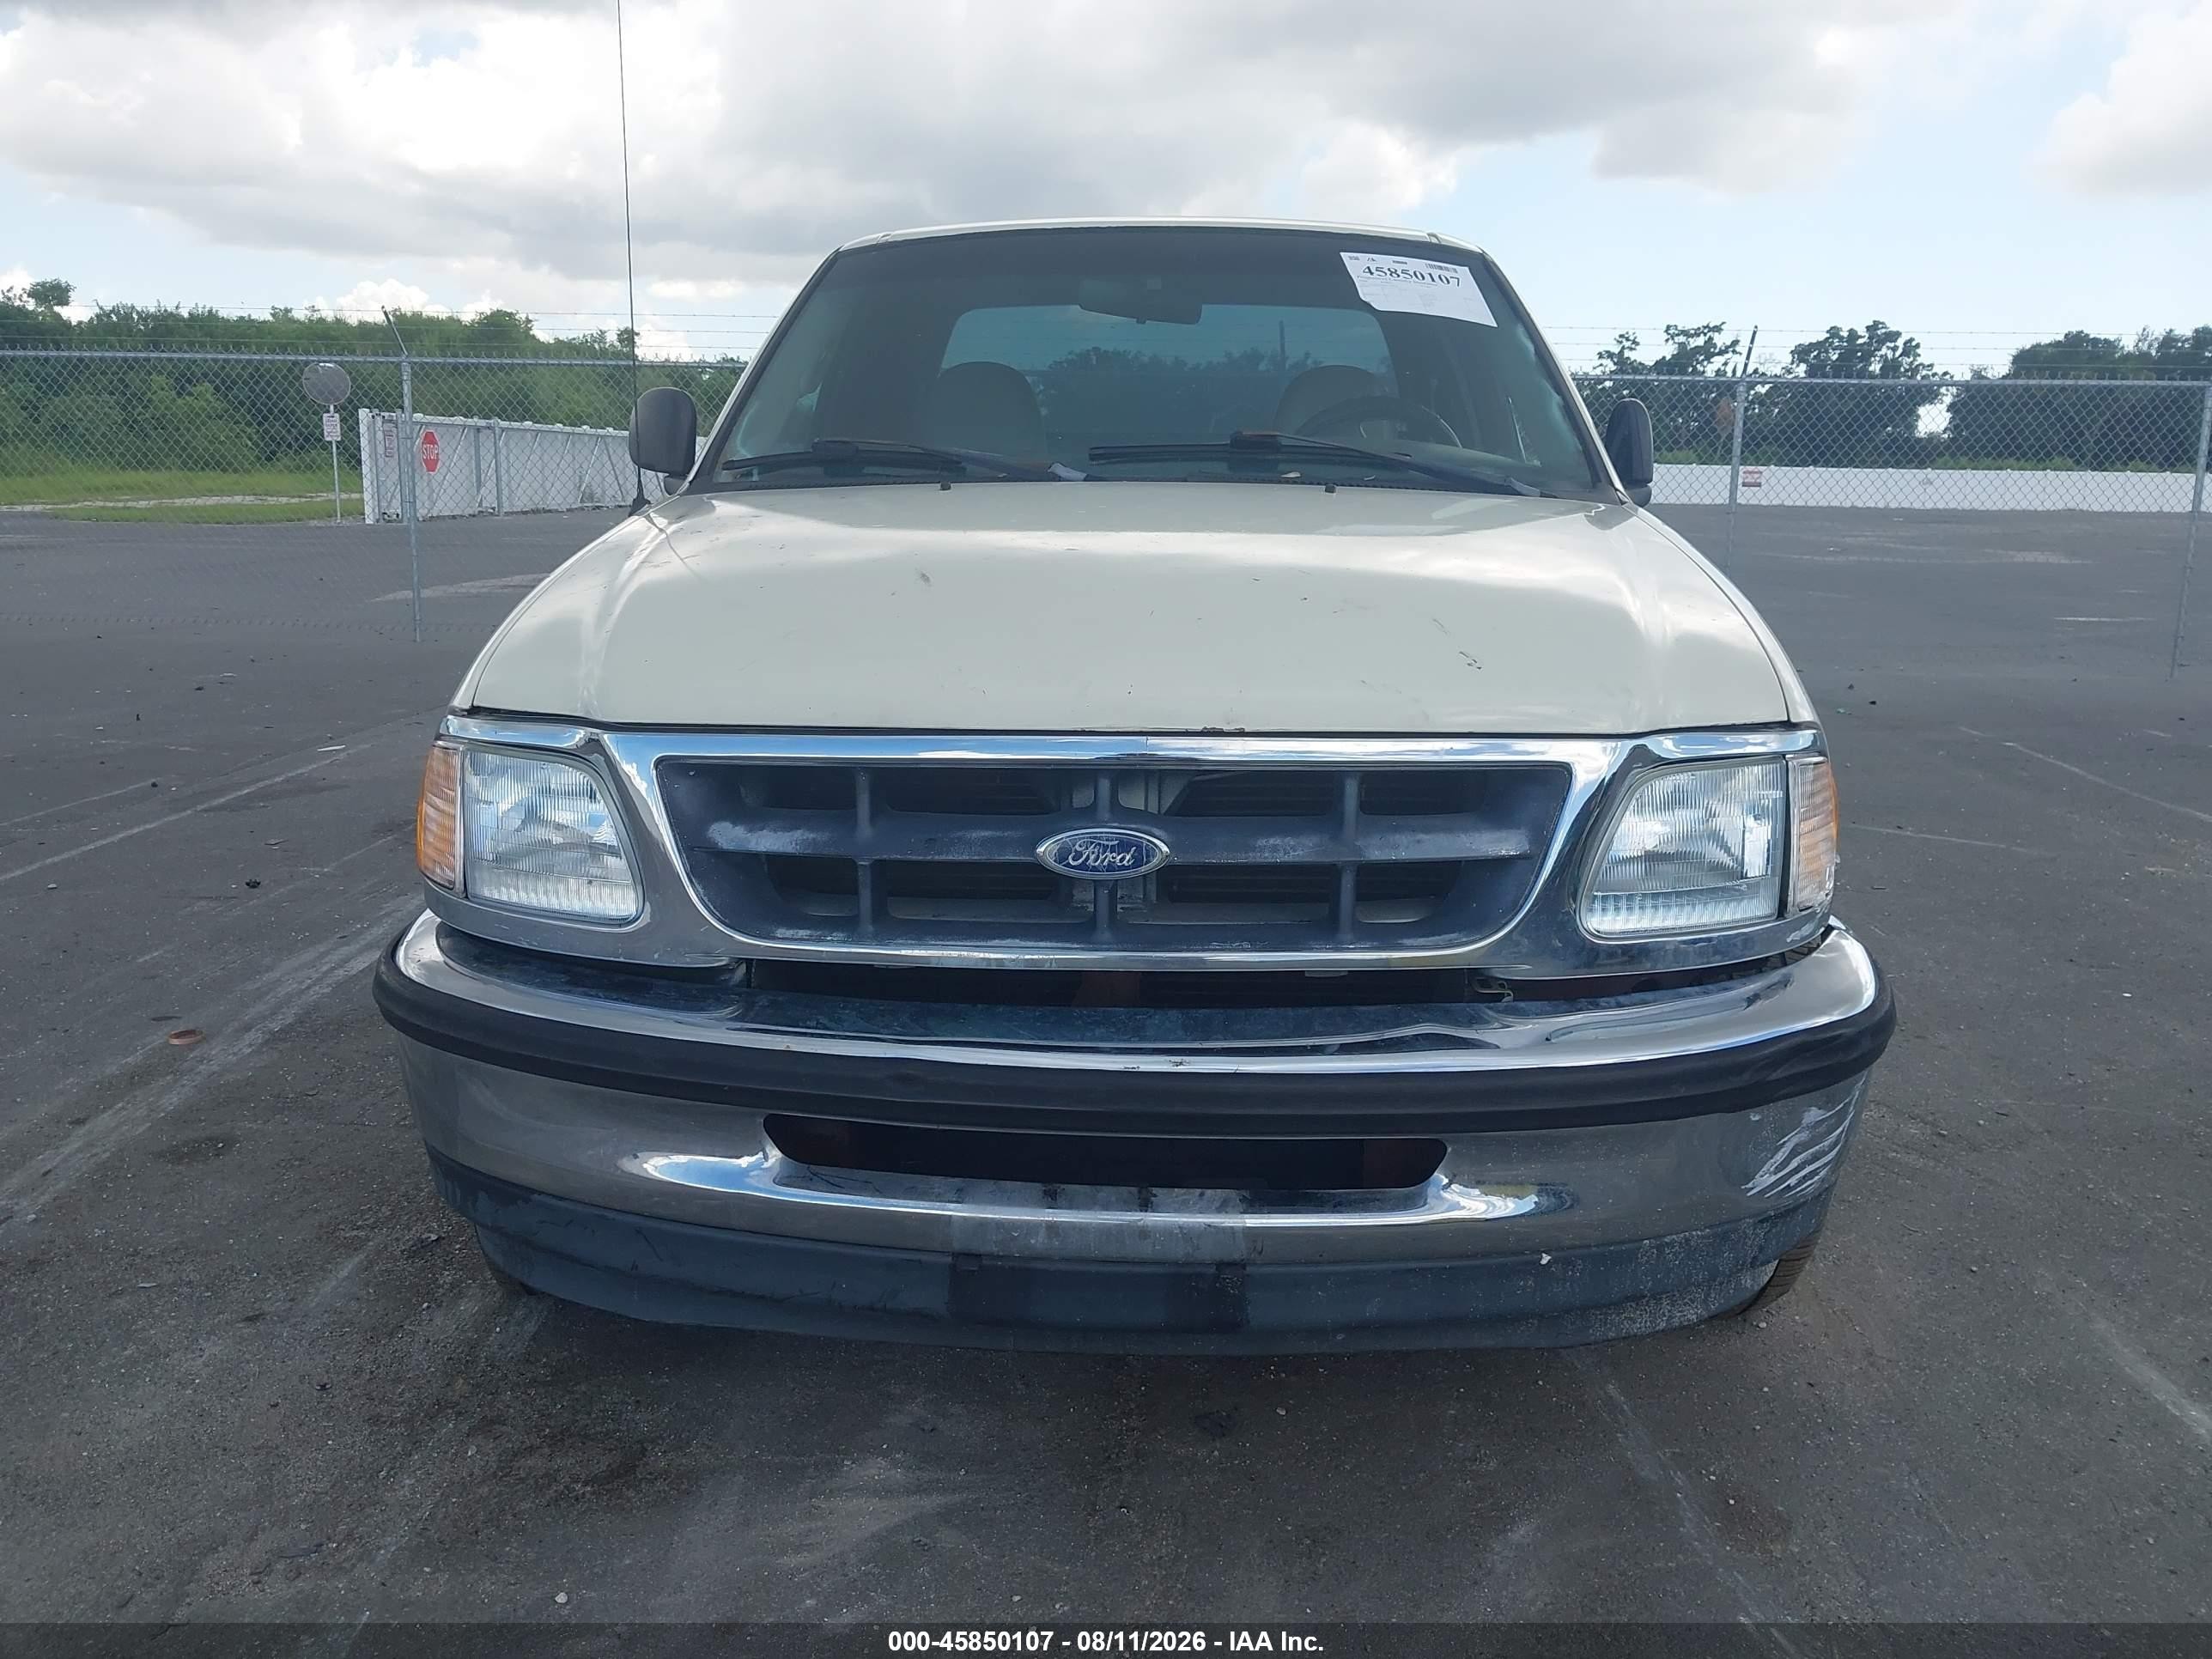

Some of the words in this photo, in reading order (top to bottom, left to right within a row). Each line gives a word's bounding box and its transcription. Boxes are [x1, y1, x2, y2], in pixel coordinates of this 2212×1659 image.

[1362, 264, 1461, 288] 45850107
[422, 444, 439, 460] STOP
[1067, 838, 1137, 866] Ford
